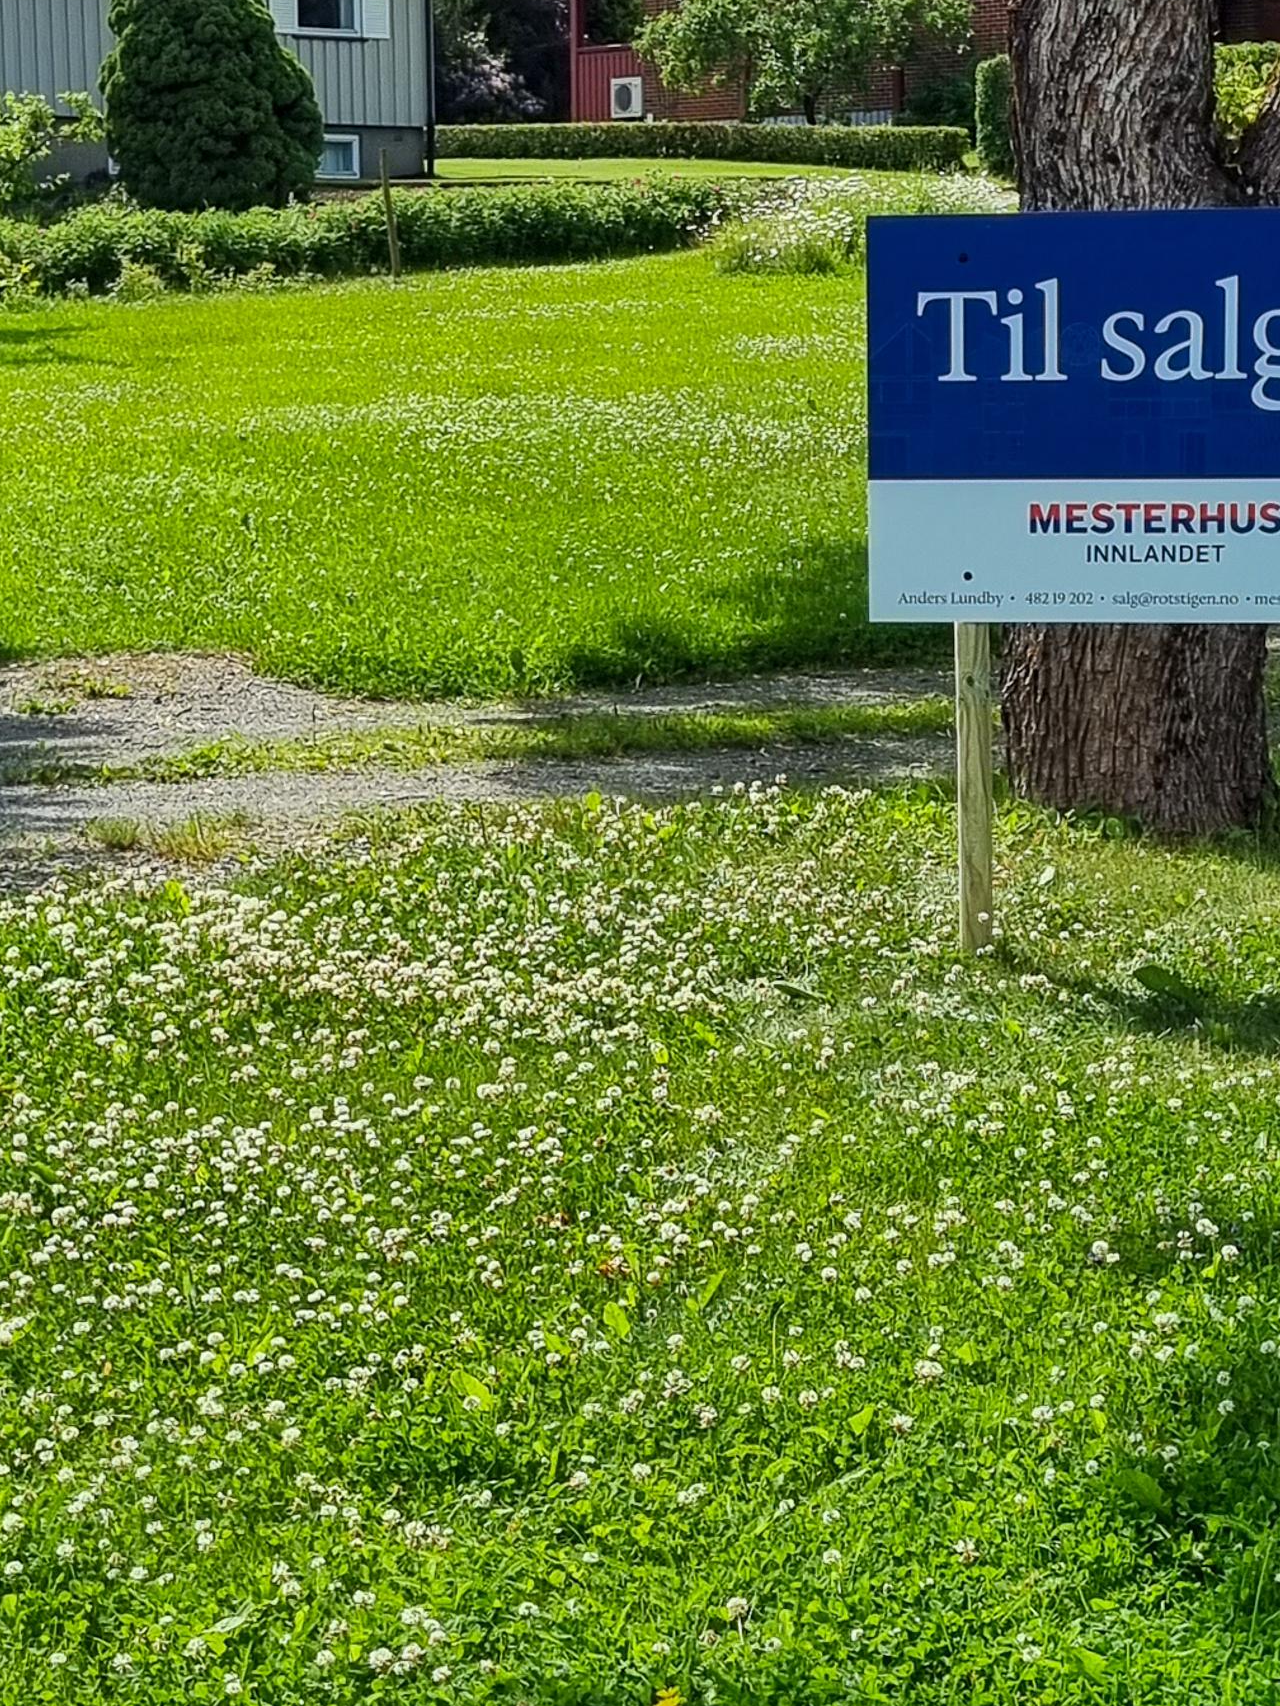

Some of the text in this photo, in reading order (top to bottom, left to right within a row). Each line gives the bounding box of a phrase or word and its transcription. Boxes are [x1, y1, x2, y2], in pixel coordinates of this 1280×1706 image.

[917, 278, 1068, 382] Til
[1086, 544, 1226, 564] INNLANDET
[898, 591, 947, 605] Anders
[950, 591, 1004, 608] Lundby
[1025, 592, 1049, 605] 482
[1069, 592, 1094, 605] 202
[1111, 591, 1239, 608] salg@rotstigen.no
